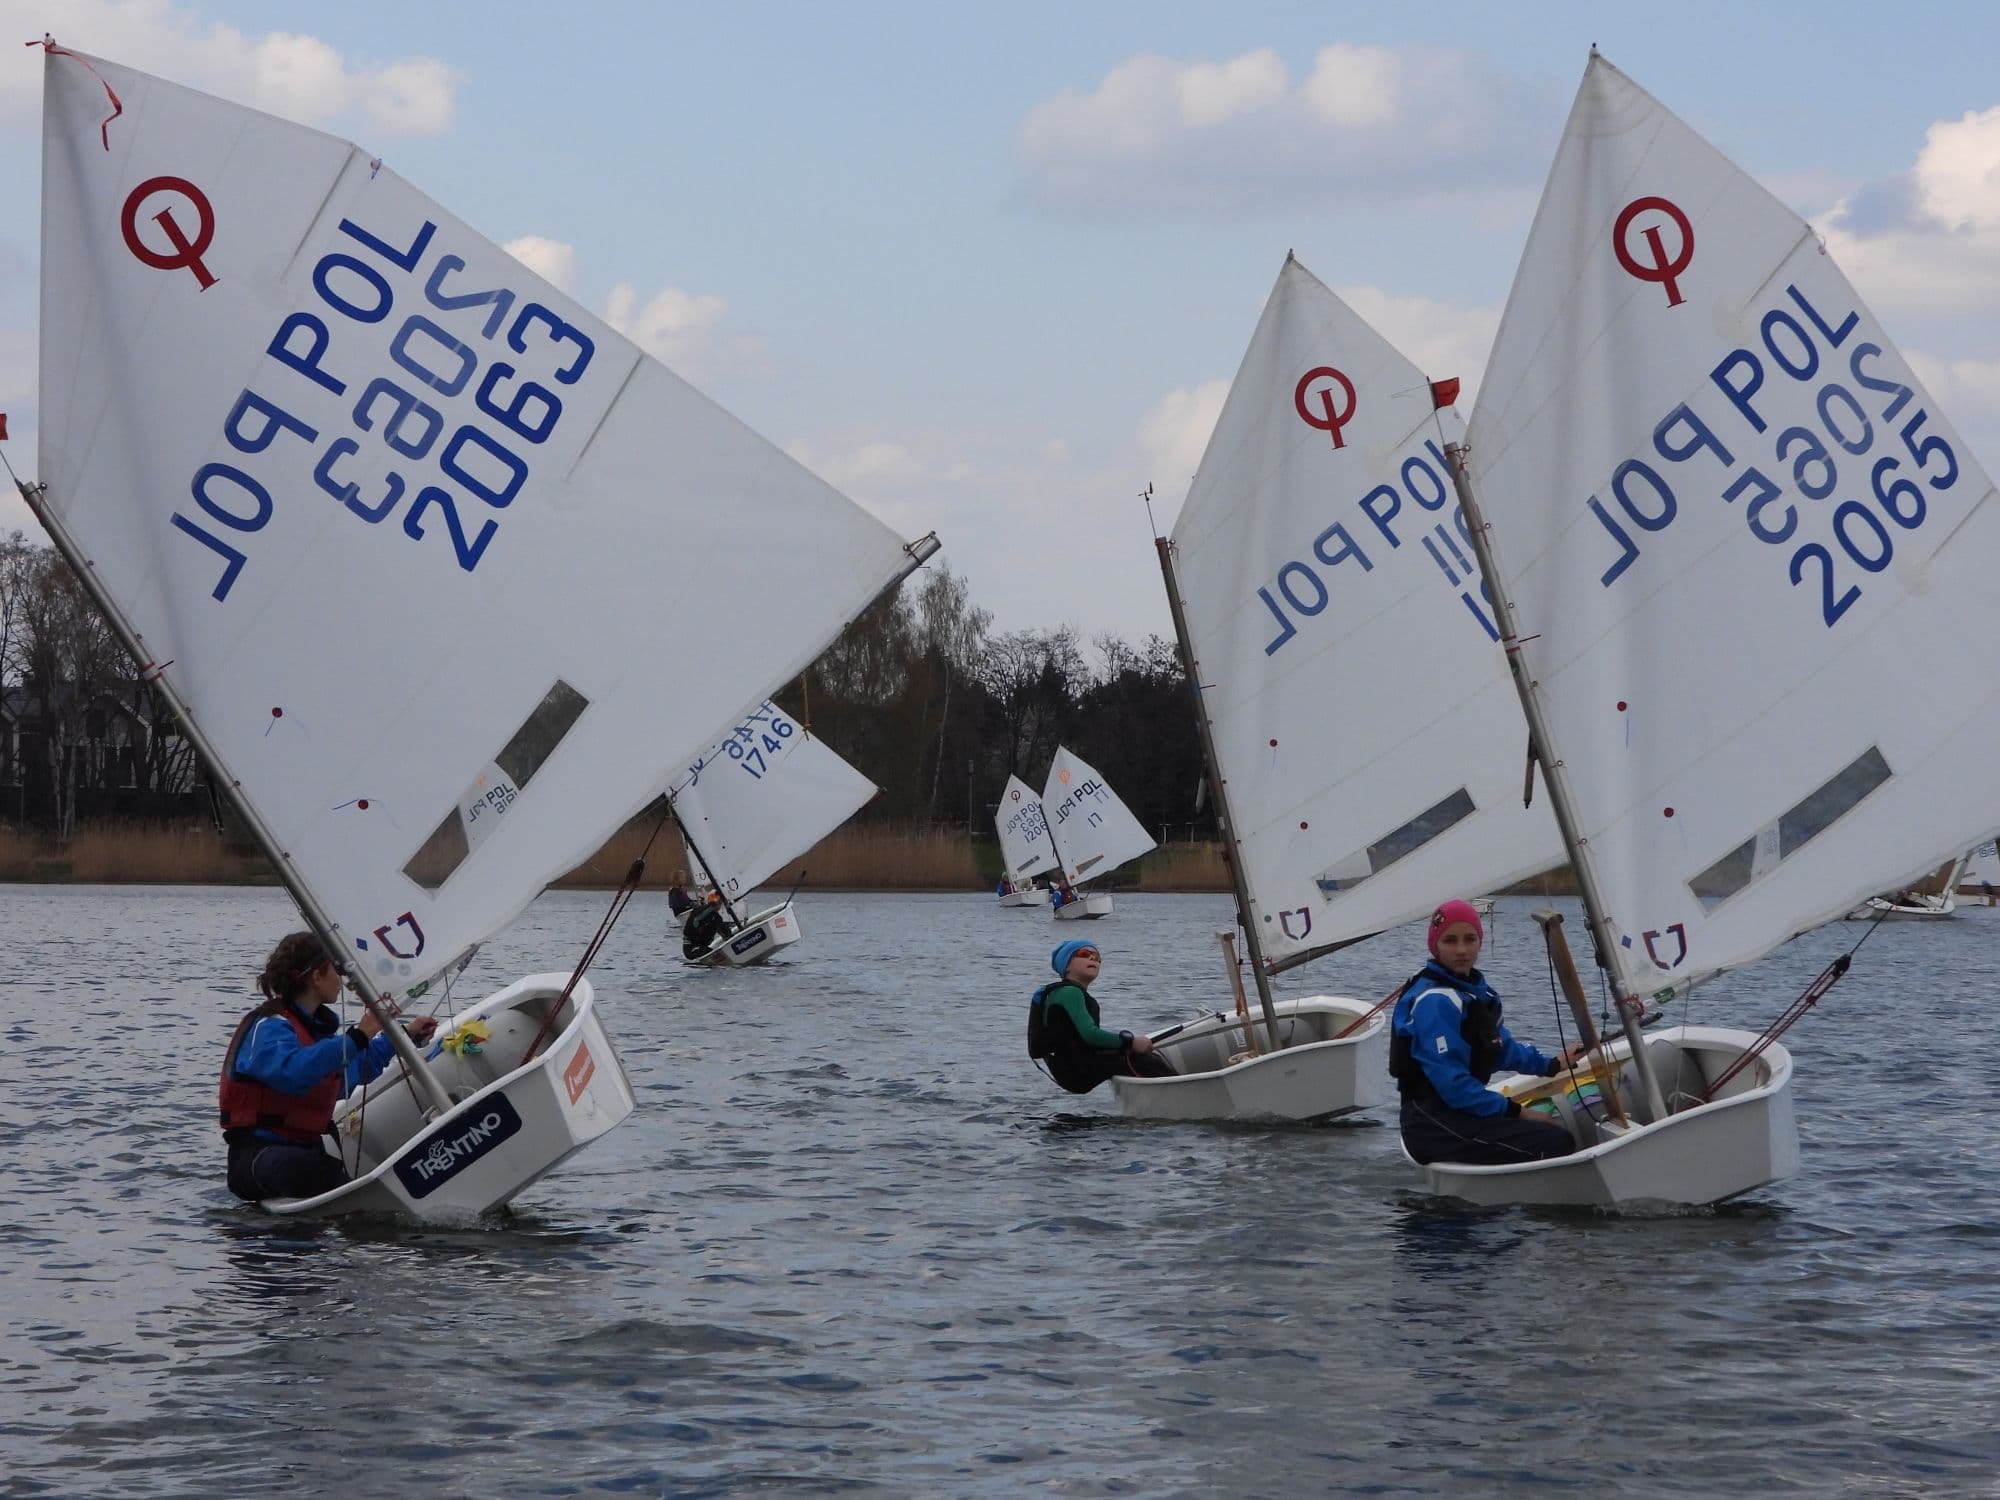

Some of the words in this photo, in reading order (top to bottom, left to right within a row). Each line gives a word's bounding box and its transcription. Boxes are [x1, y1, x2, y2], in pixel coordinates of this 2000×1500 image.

[266, 218, 437, 397] POL
[1709, 284, 1861, 434] POL
[403, 303, 596, 573] 2063
[1789, 408, 1960, 629] 2065
[741, 717, 793, 779] 1746
[486, 783, 514, 805] POL
[1074, 779, 1102, 802] POL
[1088, 812, 1103, 828] 17
[1024, 820, 1048, 844] 1206
[411, 1112, 502, 1180] TRENTINO
